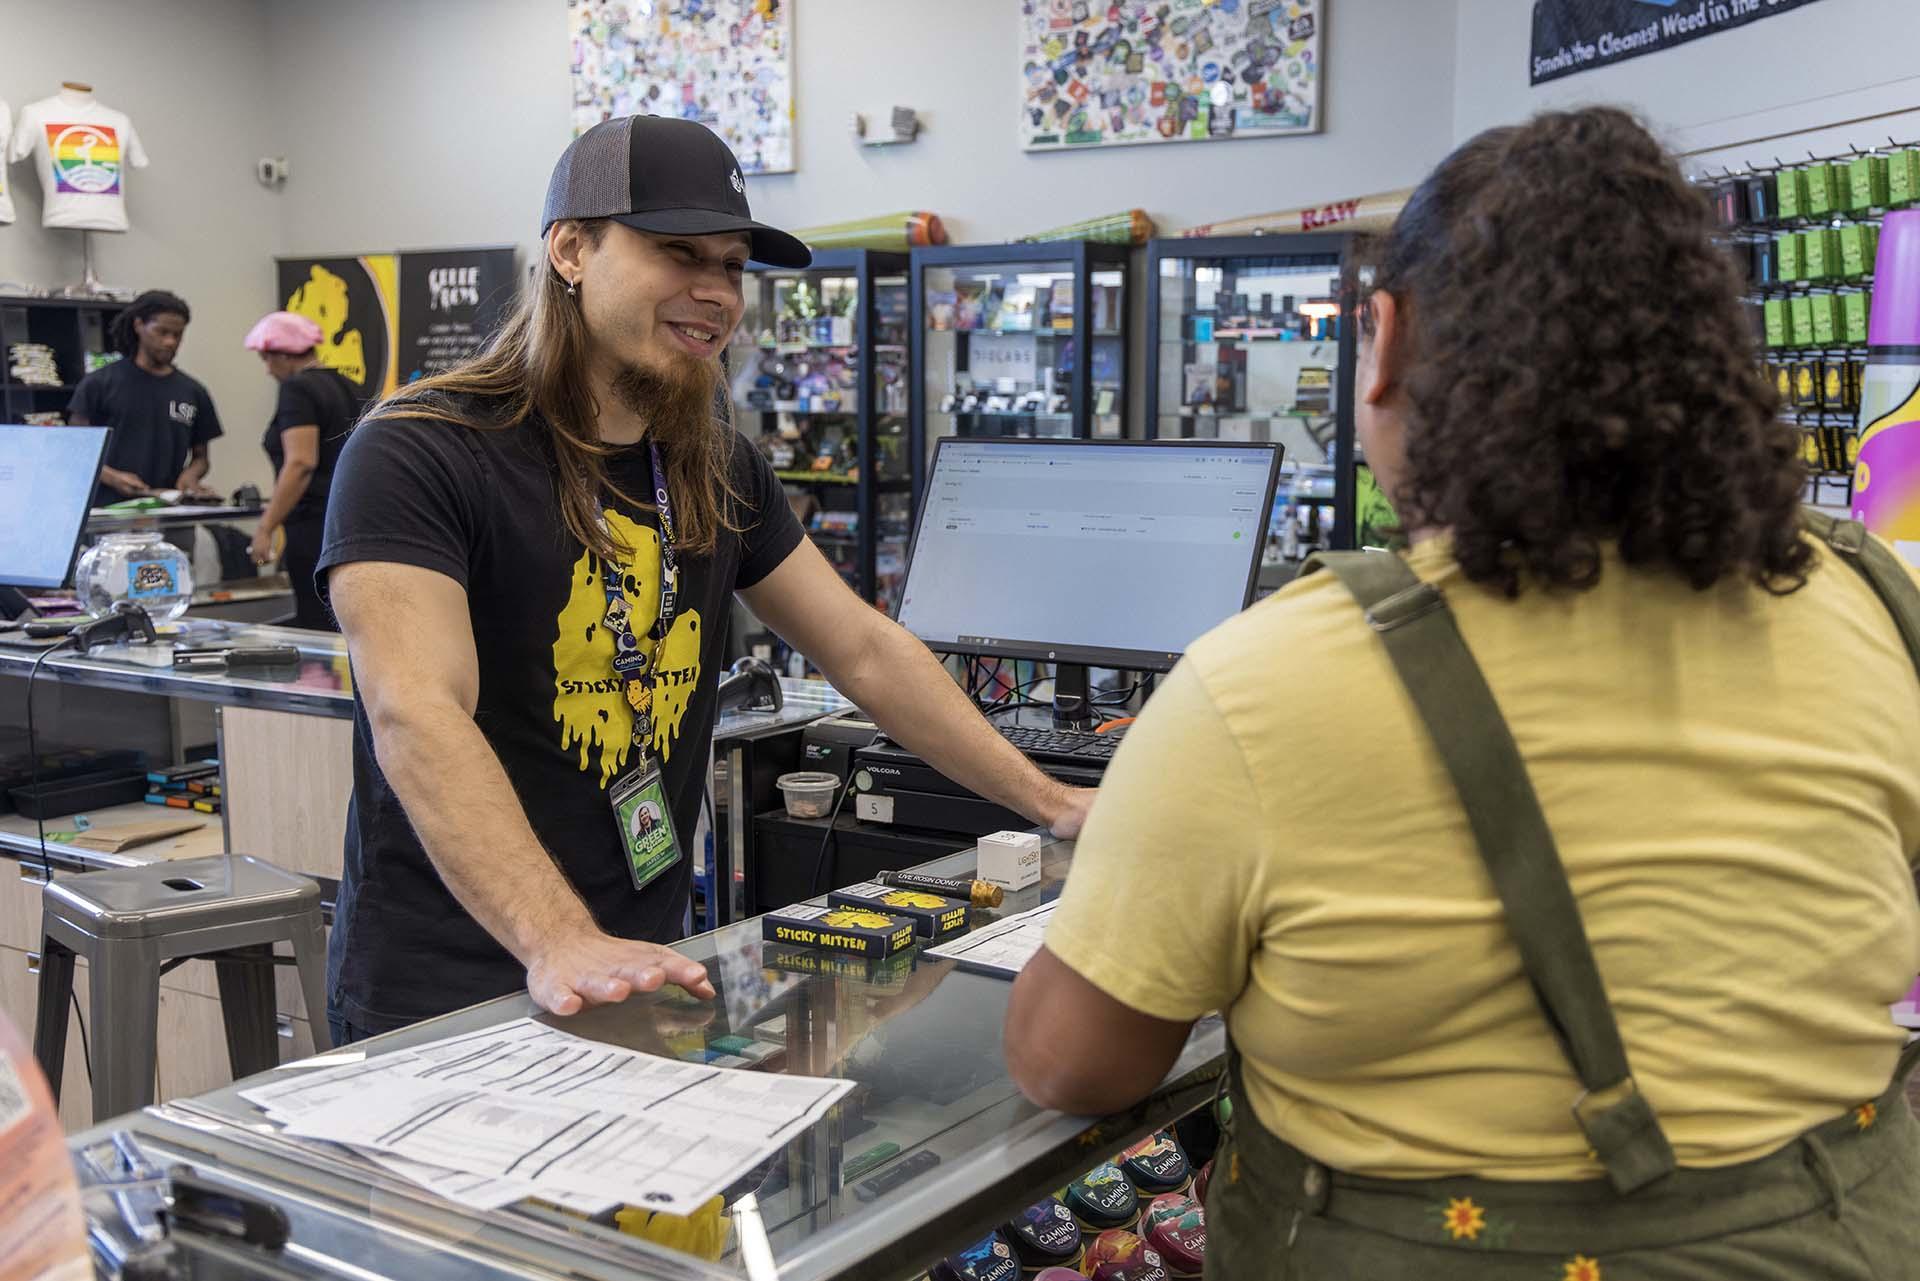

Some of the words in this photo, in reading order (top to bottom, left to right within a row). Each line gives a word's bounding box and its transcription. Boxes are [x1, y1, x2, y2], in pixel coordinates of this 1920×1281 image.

[1598, 22, 1659, 56] Cleanest
[1662, 3, 1707, 37] Weed
[1708, 0, 1730, 23] in
[1301, 199, 1362, 232] RAW
[615, 654, 644, 667] CAMINO
[560, 678, 625, 695] STICKY
[866, 766, 901, 776] VOLCORA
[871, 802, 879, 816] 5
[635, 825, 667, 852] GREEN
[914, 874, 936, 884] ROSIN
[935, 878, 961, 888] DONUT
[776, 926, 816, 943] STICKY
[820, 934, 866, 951] MITTEN
[1153, 1152, 1182, 1175] CAMINO
[1101, 1182, 1130, 1208] CAMINO
[1039, 1222, 1076, 1245] CAMINO
[980, 1259, 1015, 1281] CAMINO
